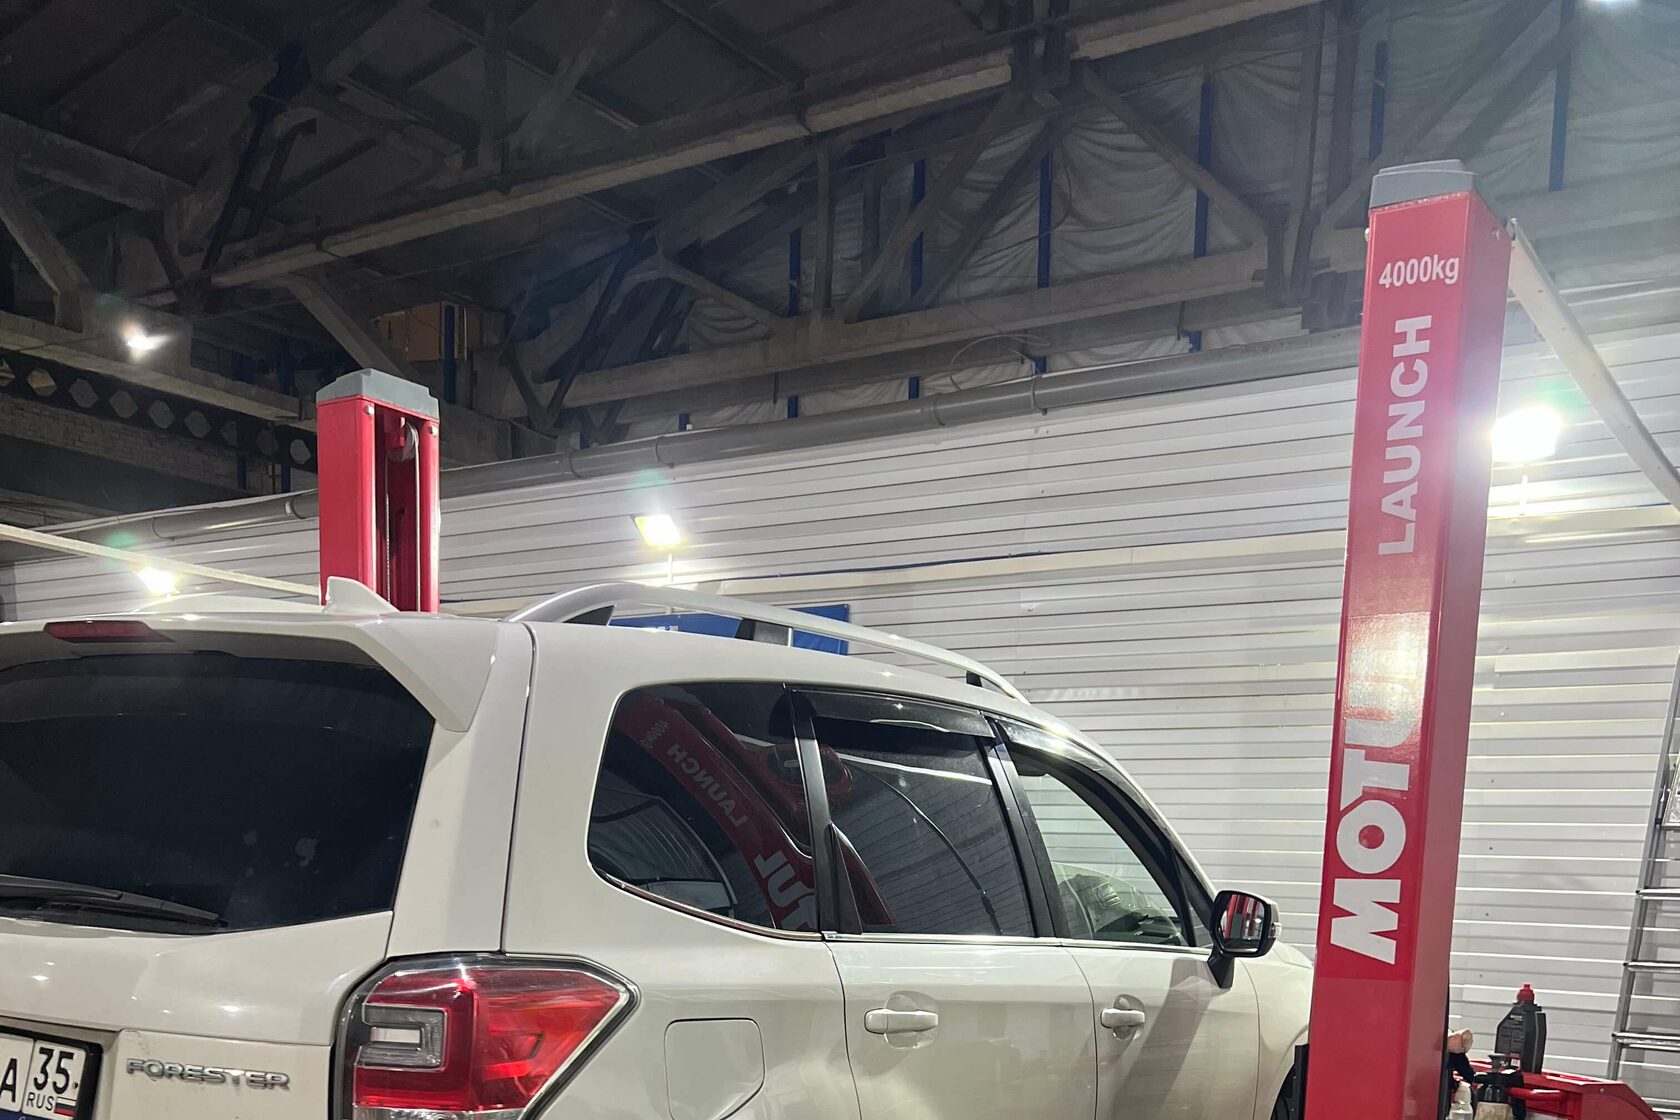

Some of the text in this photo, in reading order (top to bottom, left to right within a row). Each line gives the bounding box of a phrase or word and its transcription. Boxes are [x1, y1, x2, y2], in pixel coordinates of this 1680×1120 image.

[1379, 254, 1460, 288] 4000kg
[1378, 315, 1432, 555] LAUNCH
[33, 1047, 74, 1095] 35
[126, 1058, 290, 1090] FORESTER
[26, 1092, 55, 1111] RUS
